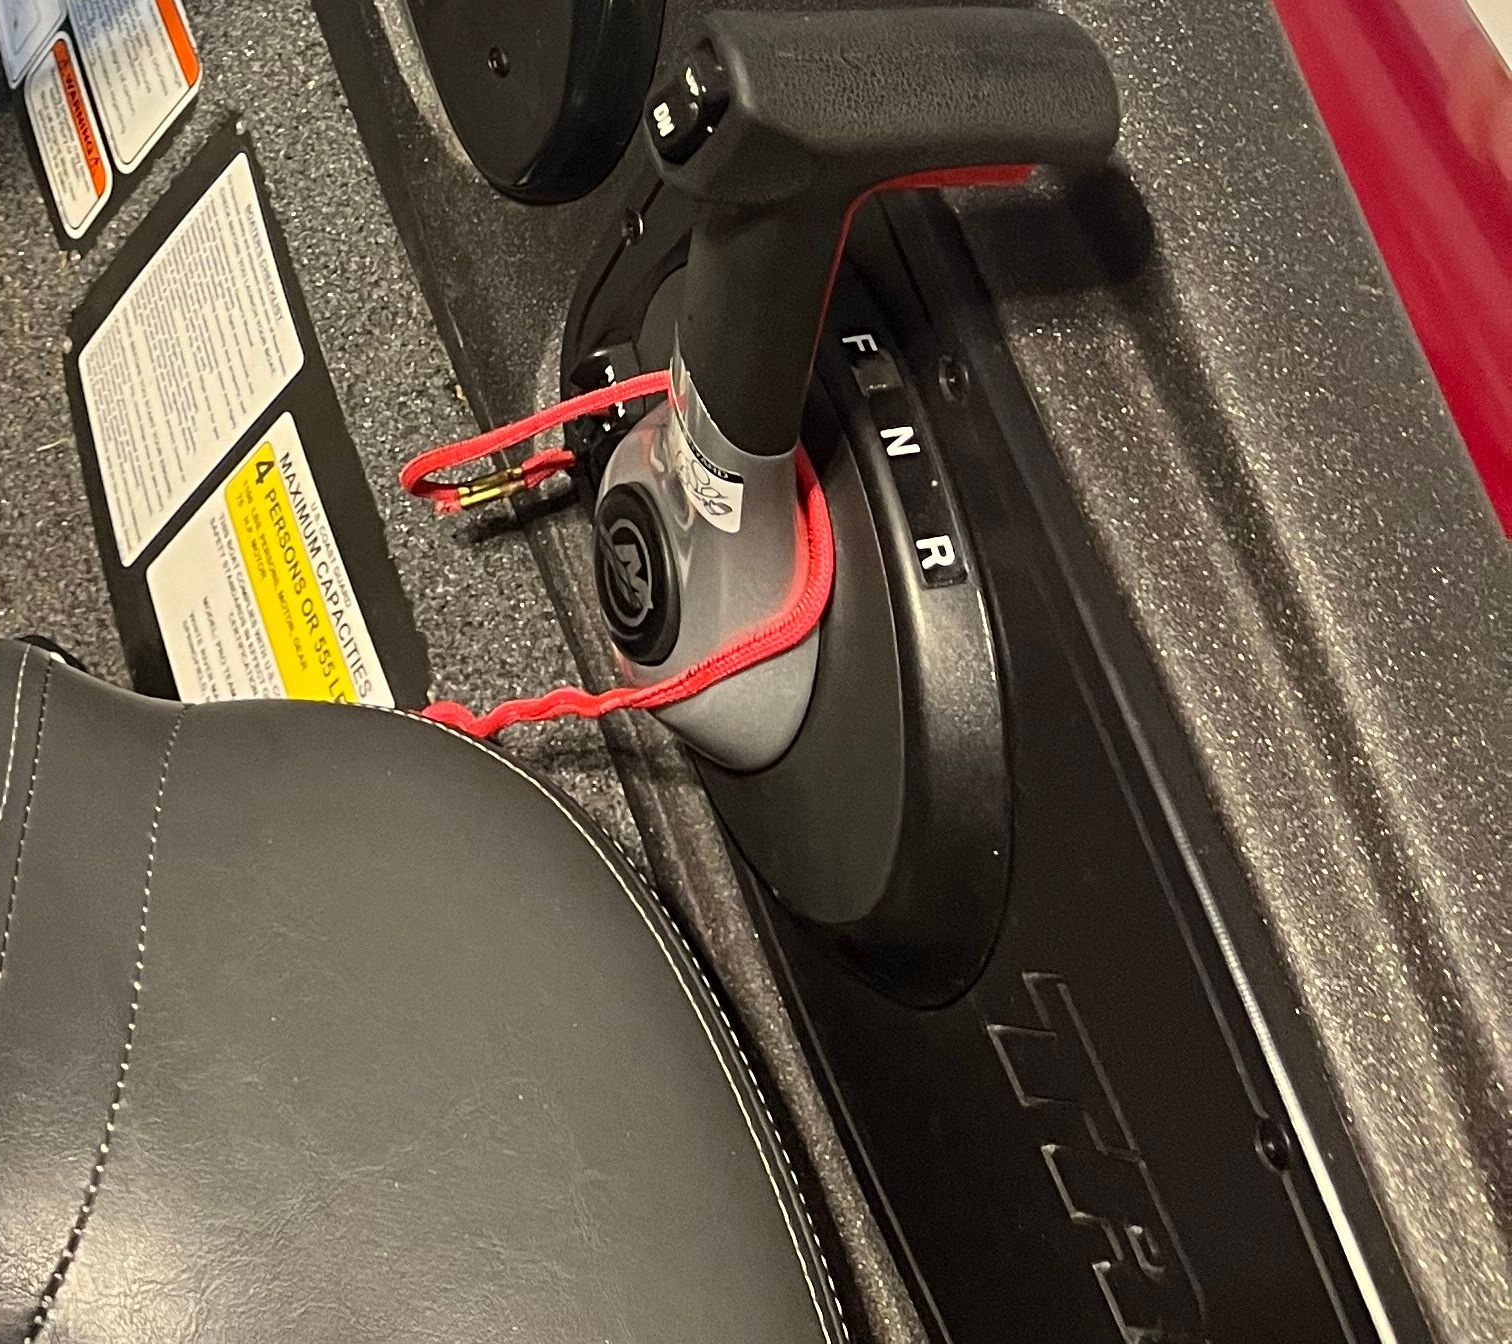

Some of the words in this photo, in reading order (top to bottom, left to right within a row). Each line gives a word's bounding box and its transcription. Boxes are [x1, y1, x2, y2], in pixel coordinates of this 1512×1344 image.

[842, 333, 879, 352] F
[880, 426, 921, 457] N
[255, 460, 274, 484] 4
[265, 488, 305, 594] PERSONS
[301, 597, 319, 632] OR
[314, 636, 334, 677] 555
[280, 452, 321, 557] MAXIMUM
[316, 561, 368, 697] CAPACITIES
[319, 525, 336, 563] COAST
[333, 565, 351, 607] GUARD
[915, 534, 956, 570] R
